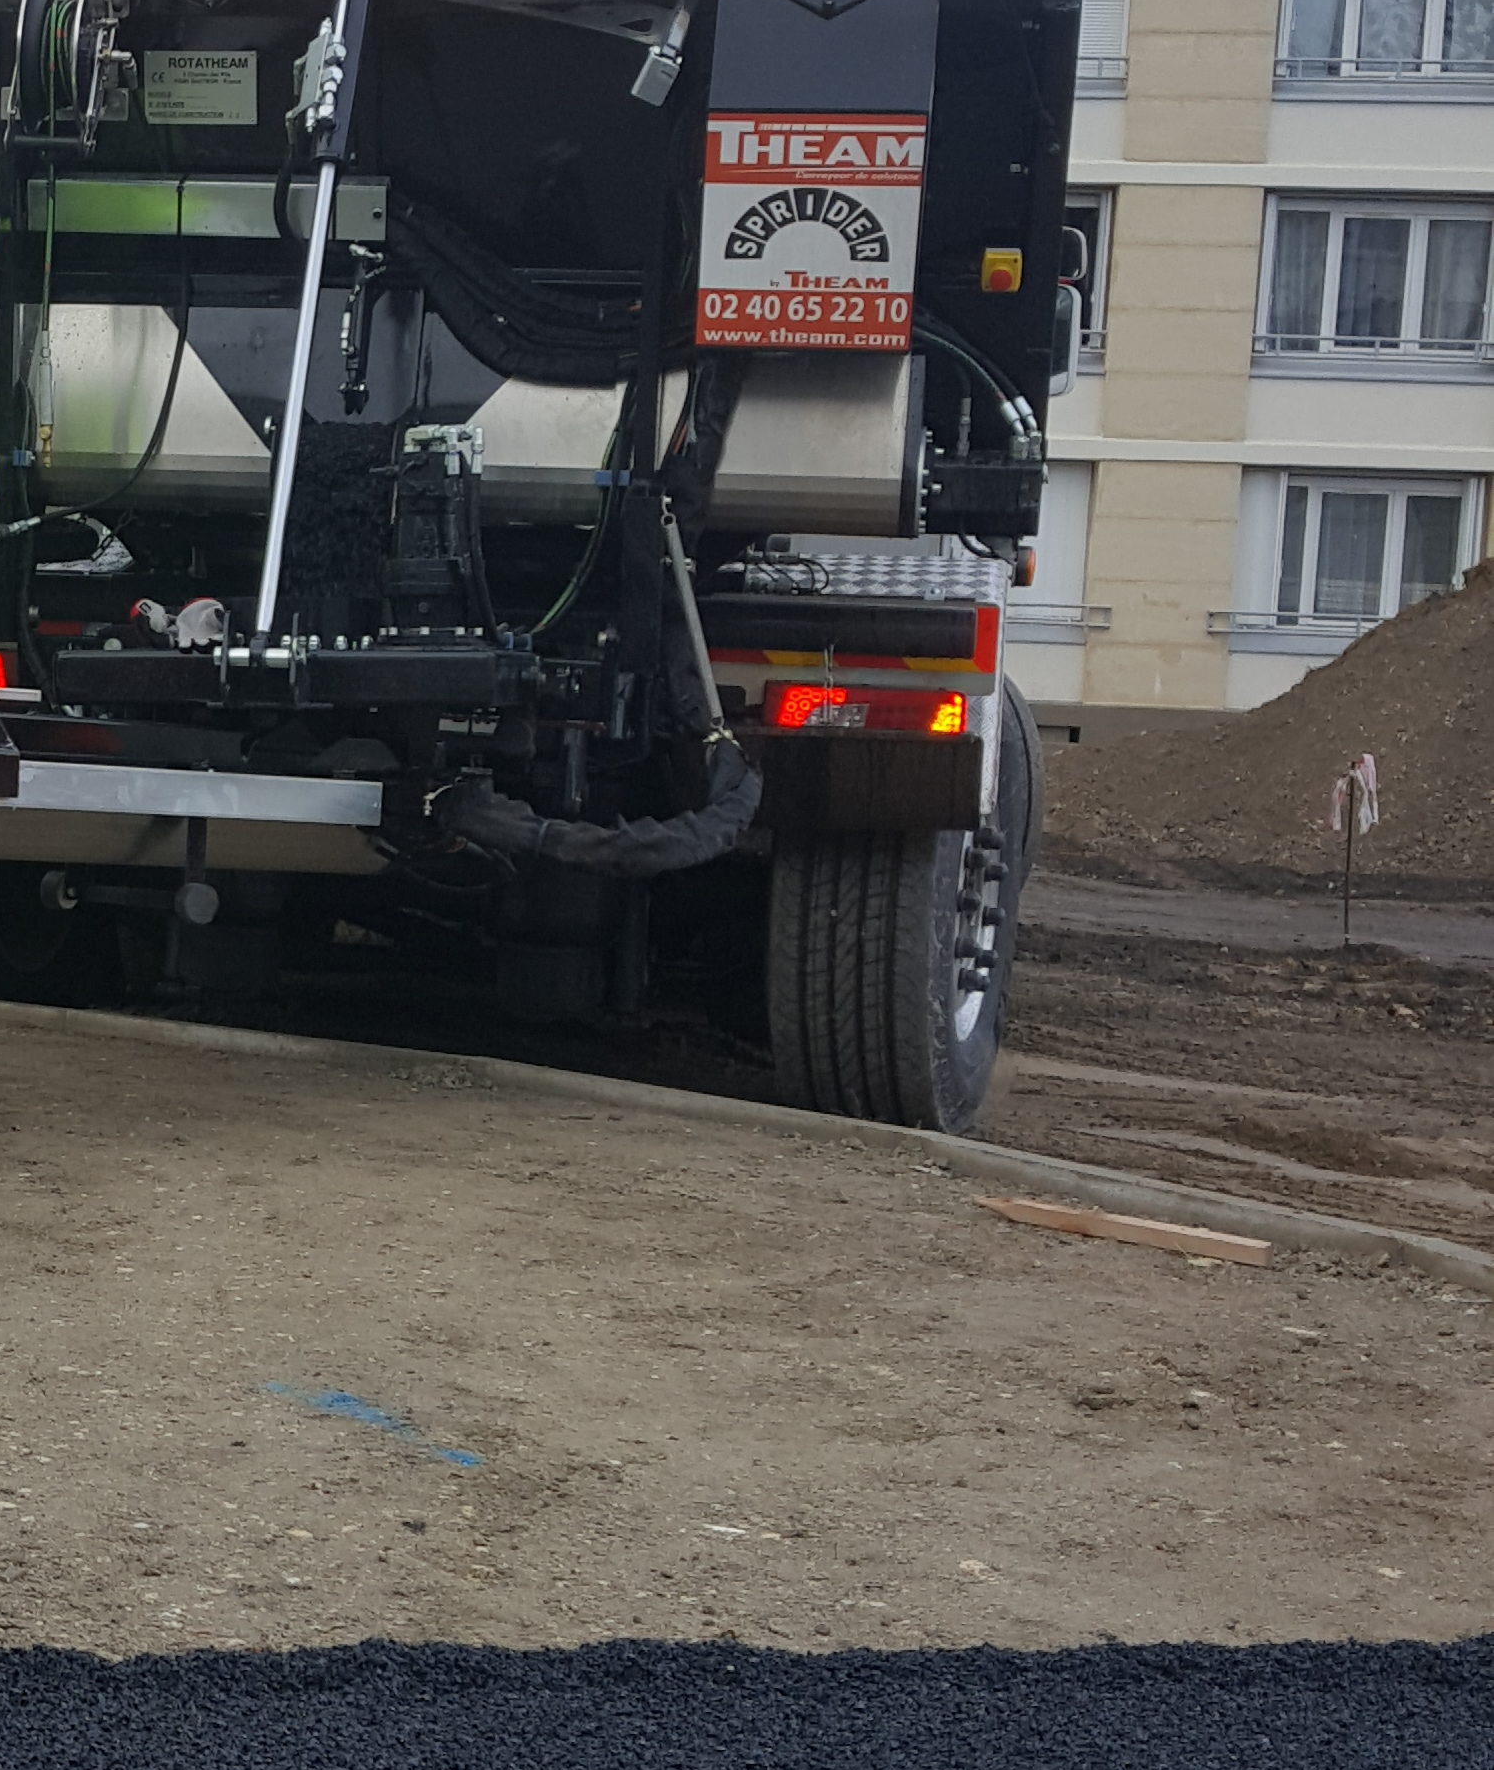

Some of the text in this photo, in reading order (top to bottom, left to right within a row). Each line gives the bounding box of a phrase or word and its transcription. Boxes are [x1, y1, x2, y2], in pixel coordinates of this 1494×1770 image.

[168, 57, 249, 69] ROTATHEAM
[730, 191, 884, 261] SPRIDER
[770, 279, 780, 288] by
[704, 293, 908, 323] 02 40 65 22 10
[703, 327, 907, 347] www.theam.com
